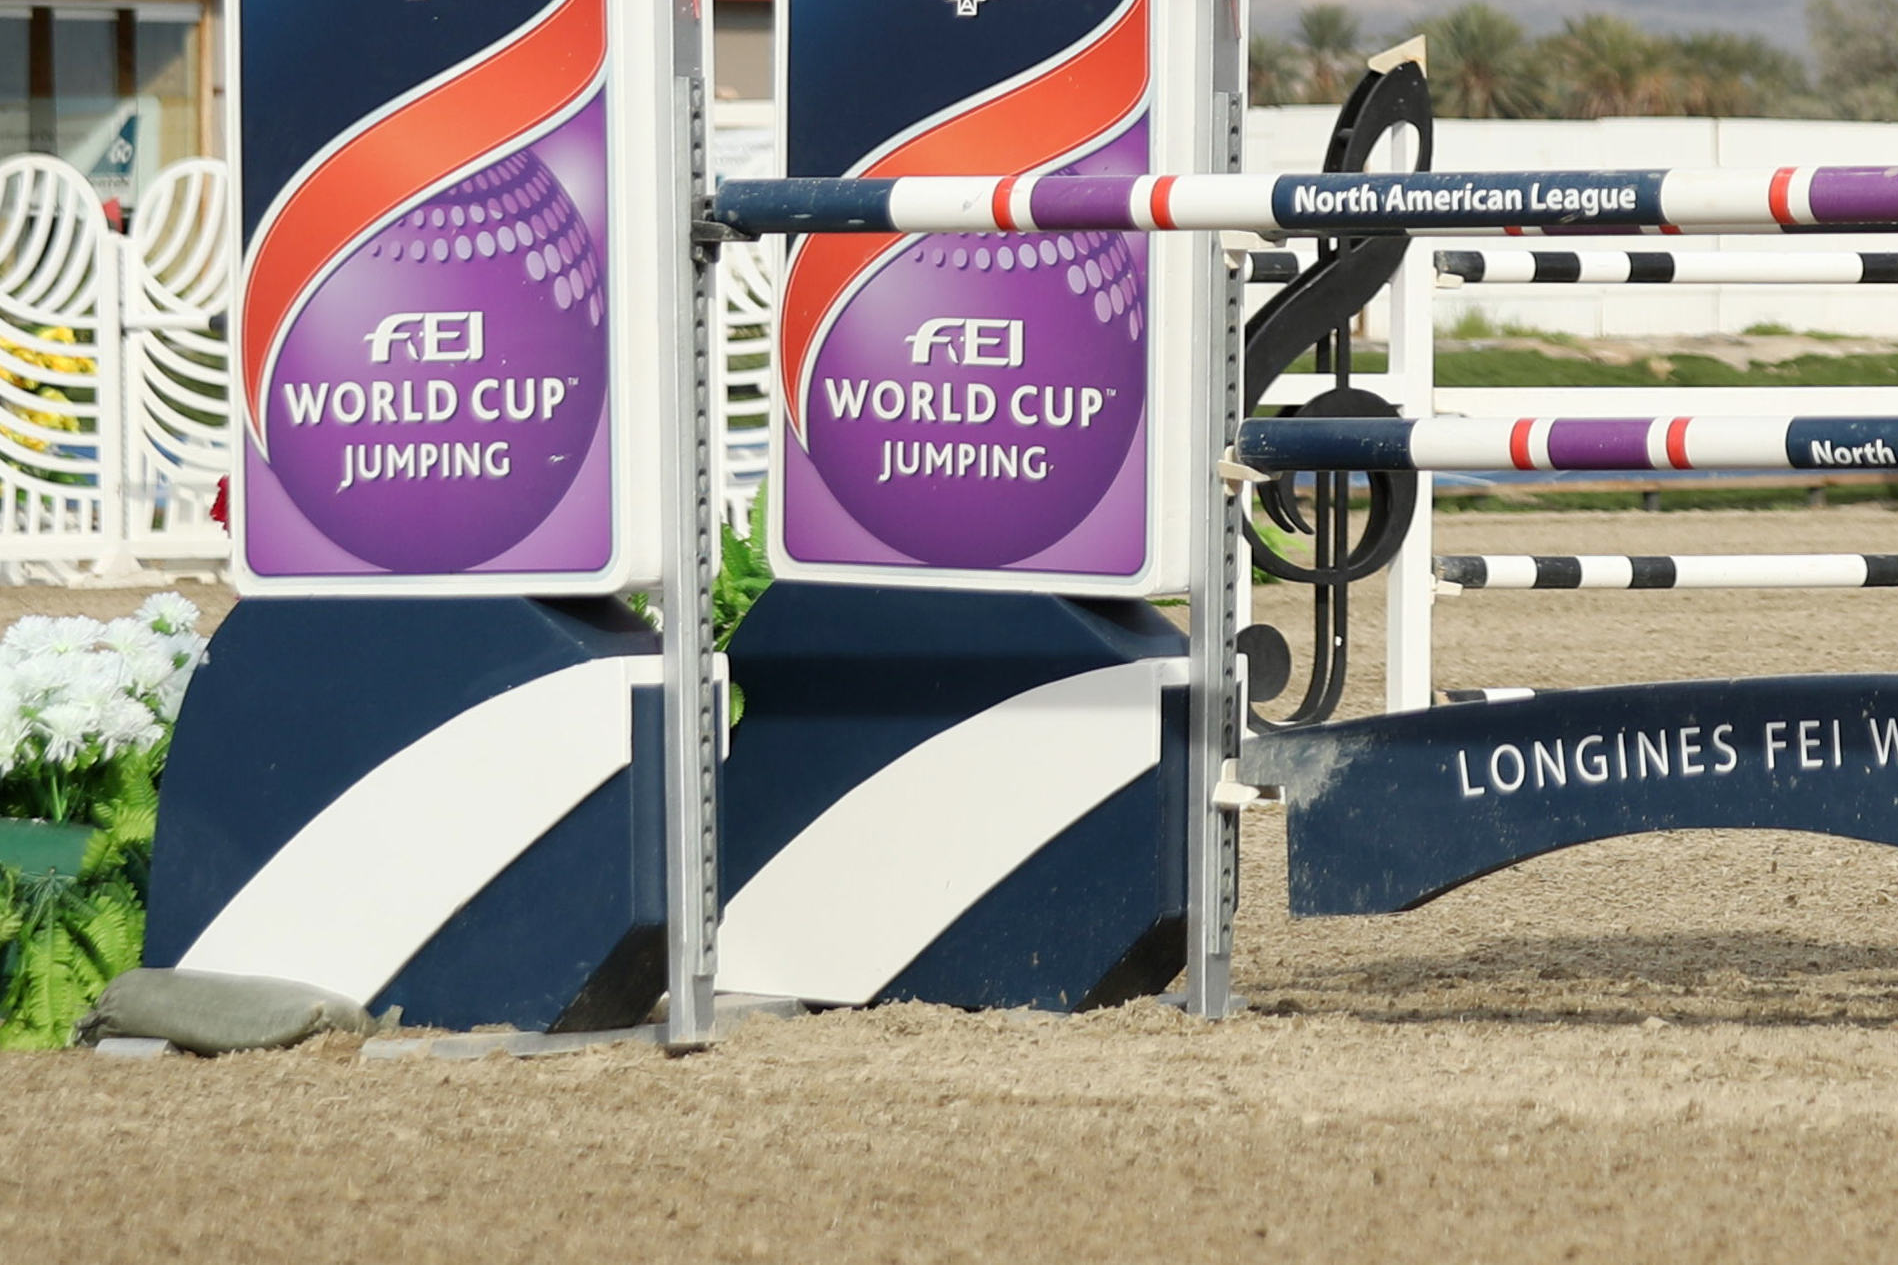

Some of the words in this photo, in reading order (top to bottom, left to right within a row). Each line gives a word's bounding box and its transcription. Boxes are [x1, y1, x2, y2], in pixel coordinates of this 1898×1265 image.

[1294, 183, 1378, 213] North
[1385, 182, 1523, 212] American
[1529, 182, 1636, 216] League
[364, 311, 484, 362] FEI
[905, 317, 1023, 366] FEI
[284, 380, 457, 424] WORLD
[825, 378, 996, 422] WORLD
[338, 442, 511, 489] JUMPING
[877, 441, 1047, 483] JUMPING
[1810, 438, 1896, 465] North
[1457, 723, 1738, 797] LONGINES
[1765, 718, 1842, 770] FEI
